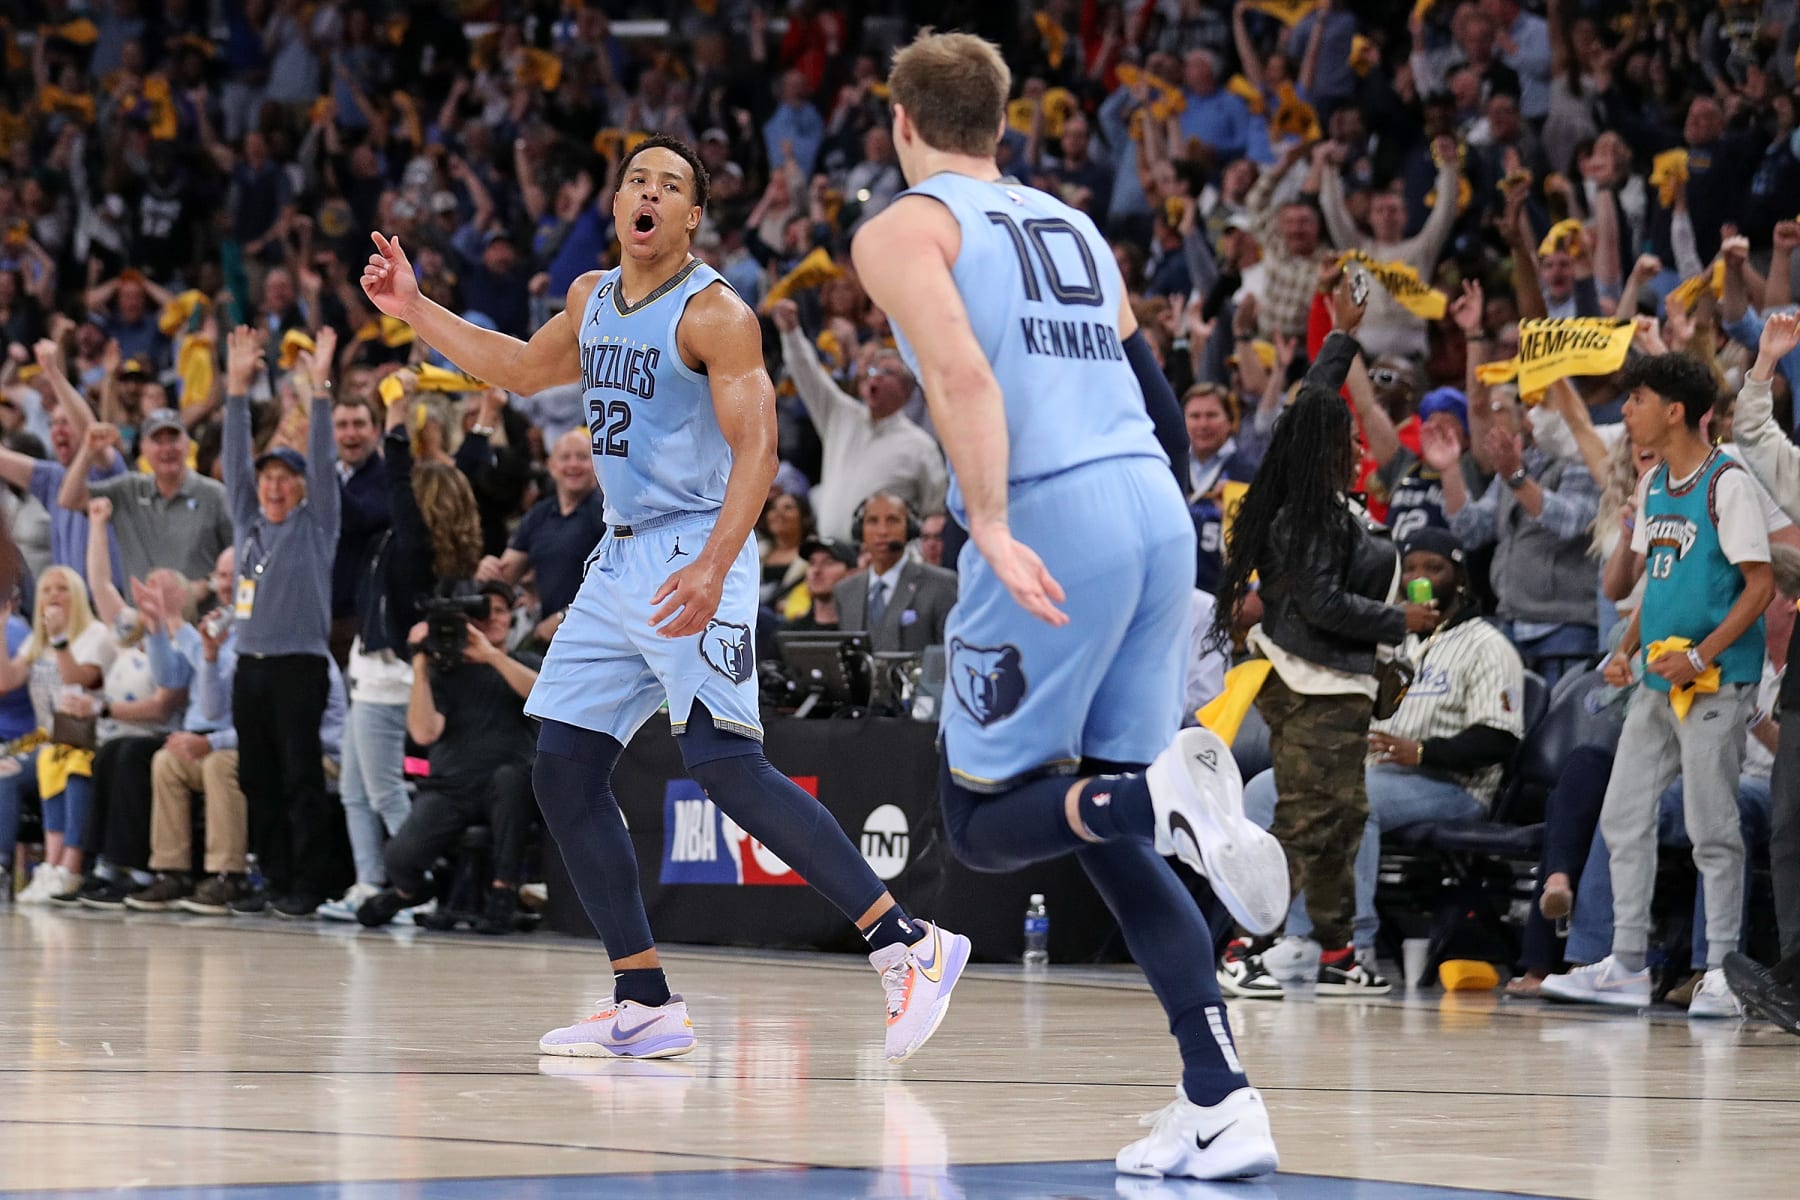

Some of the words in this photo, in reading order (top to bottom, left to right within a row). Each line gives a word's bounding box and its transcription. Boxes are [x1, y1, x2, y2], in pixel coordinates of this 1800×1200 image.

[984, 211, 1104, 307] 10
[1021, 317, 1123, 361] KENNARD
[590, 399, 632, 458] 22
[1651, 552, 1674, 579] 13
[671, 799, 717, 862] NBA
[862, 830, 909, 858] TNT
